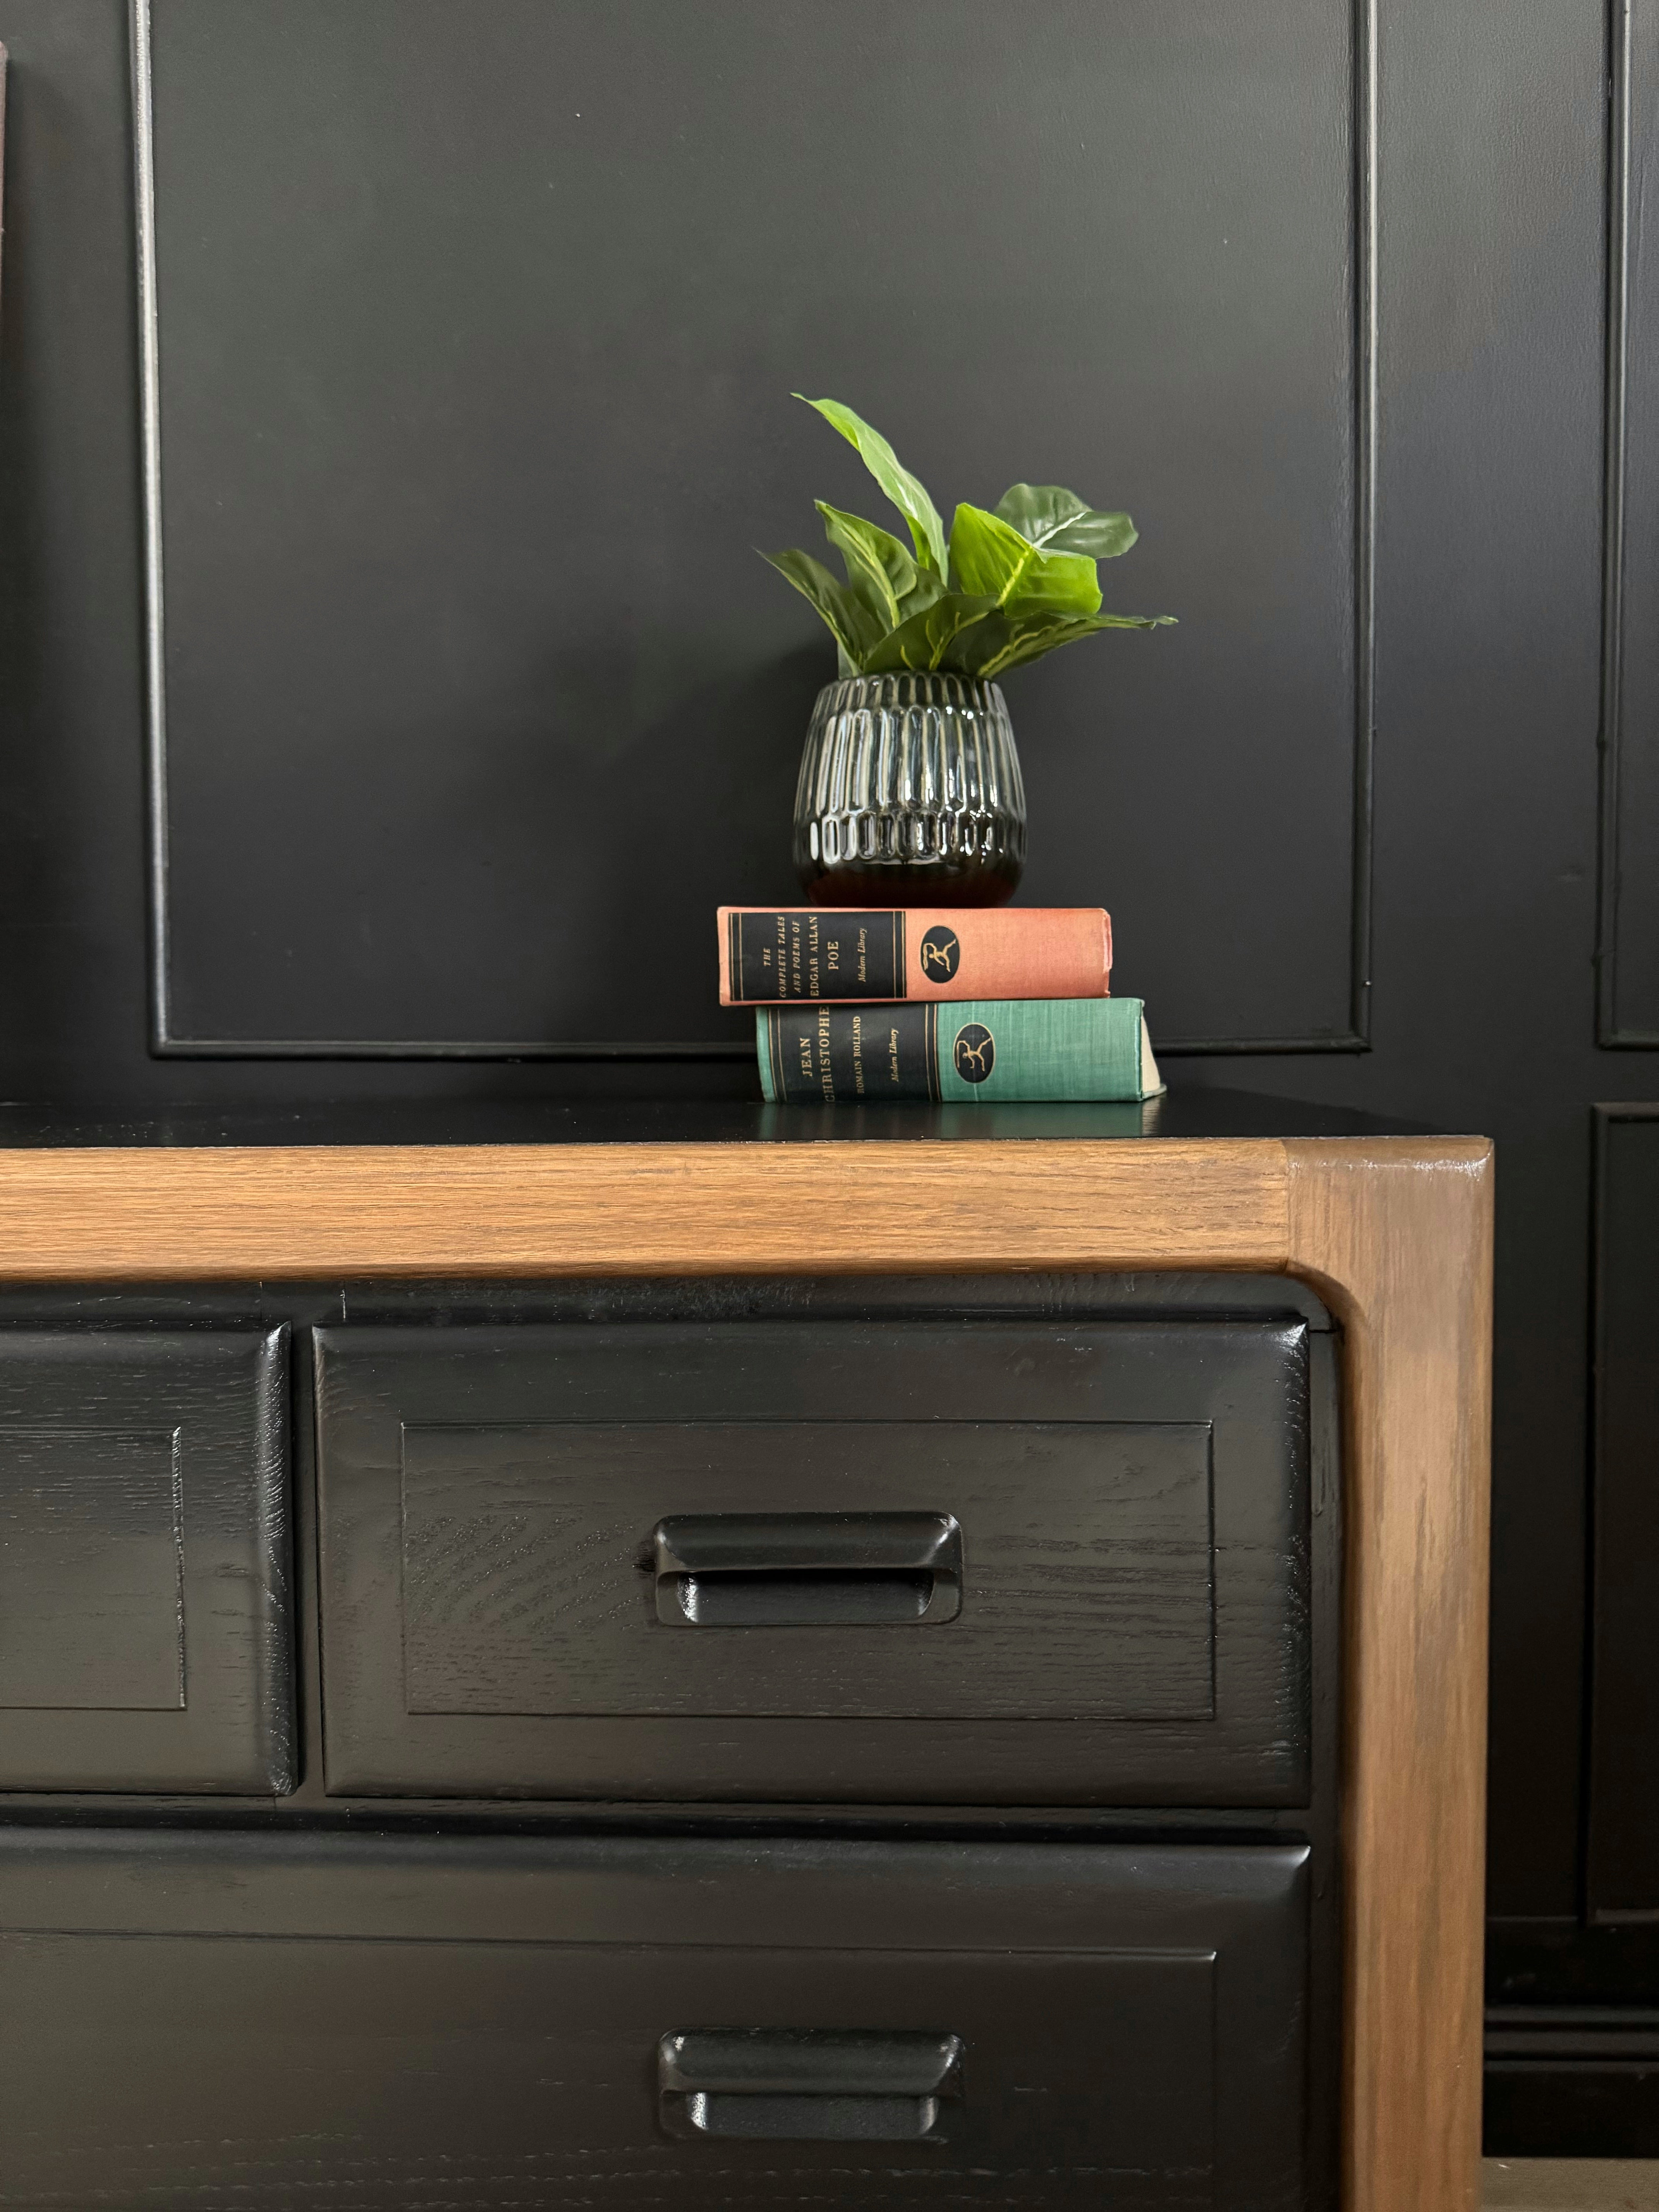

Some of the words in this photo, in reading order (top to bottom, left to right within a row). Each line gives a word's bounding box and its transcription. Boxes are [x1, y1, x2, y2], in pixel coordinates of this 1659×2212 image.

[793, 921, 800, 933] OF
[809, 916, 818, 952] ALLAN
[858, 928, 867, 953] Library
[828, 941, 839, 970] POE
[858, 955, 866, 982] Modern
[793, 973, 801, 993] AND
[809, 959, 819, 997] EDGAR
[853, 1016, 861, 1057] ROLLAND
[889, 1028, 899, 1054] Library
[800, 1038, 812, 1077] JEAN
[819, 1007, 835, 1103] CHRISTOPHE
[891, 1056, 899, 1082] Modern
